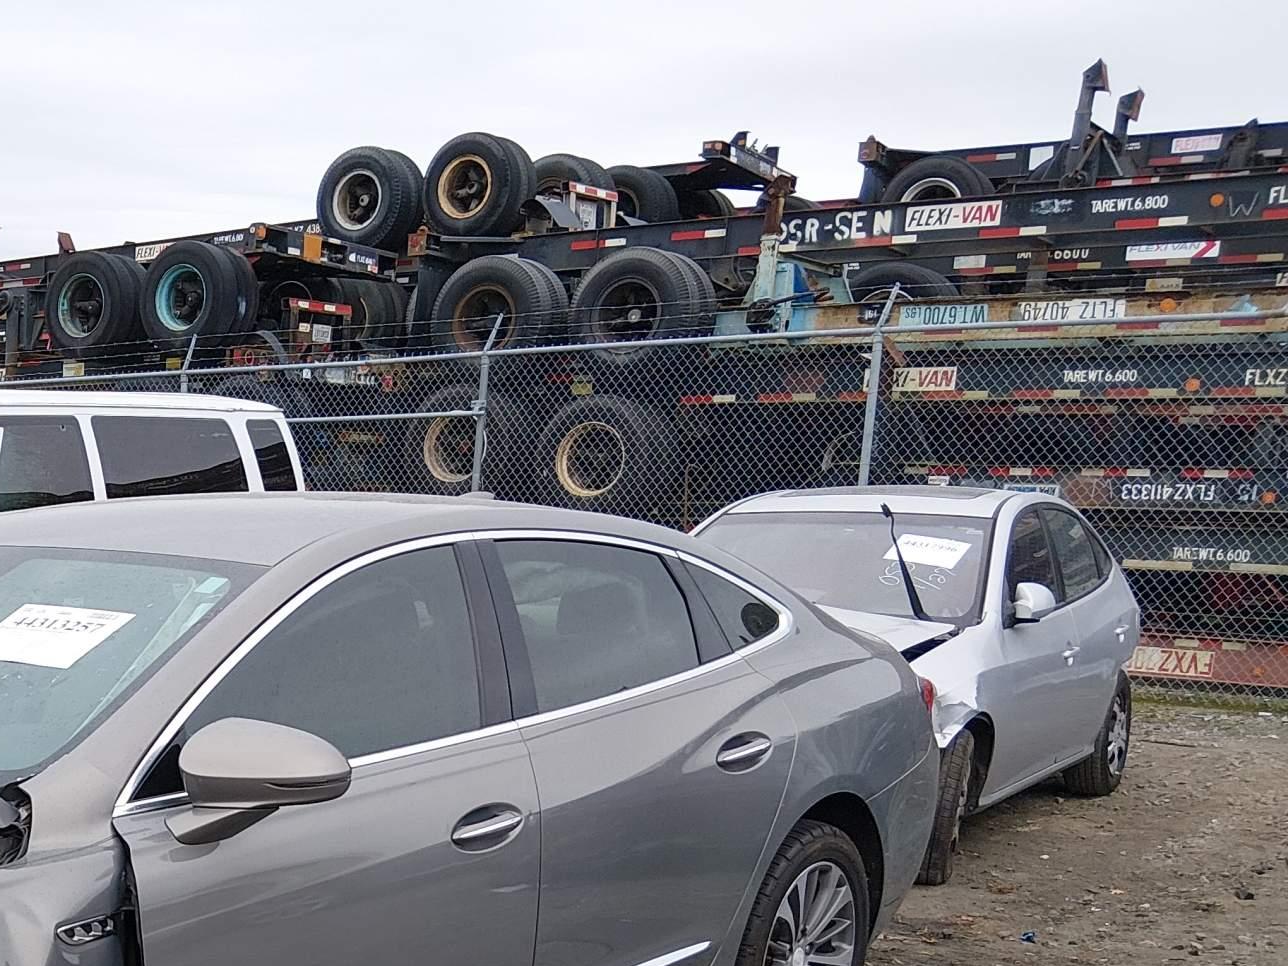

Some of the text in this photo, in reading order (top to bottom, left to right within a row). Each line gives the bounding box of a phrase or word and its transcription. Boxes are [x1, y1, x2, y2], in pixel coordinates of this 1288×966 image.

[908, 203, 1001, 228] FLEXI-VAN
[1079, 300, 1117, 320] FLTZ
[1244, 368, 1288, 386] FLXZ
[1174, 484, 1215, 501] FLXZ
[14, 617, 106, 633] 44313257
[1160, 650, 1214, 676] FVXZ
